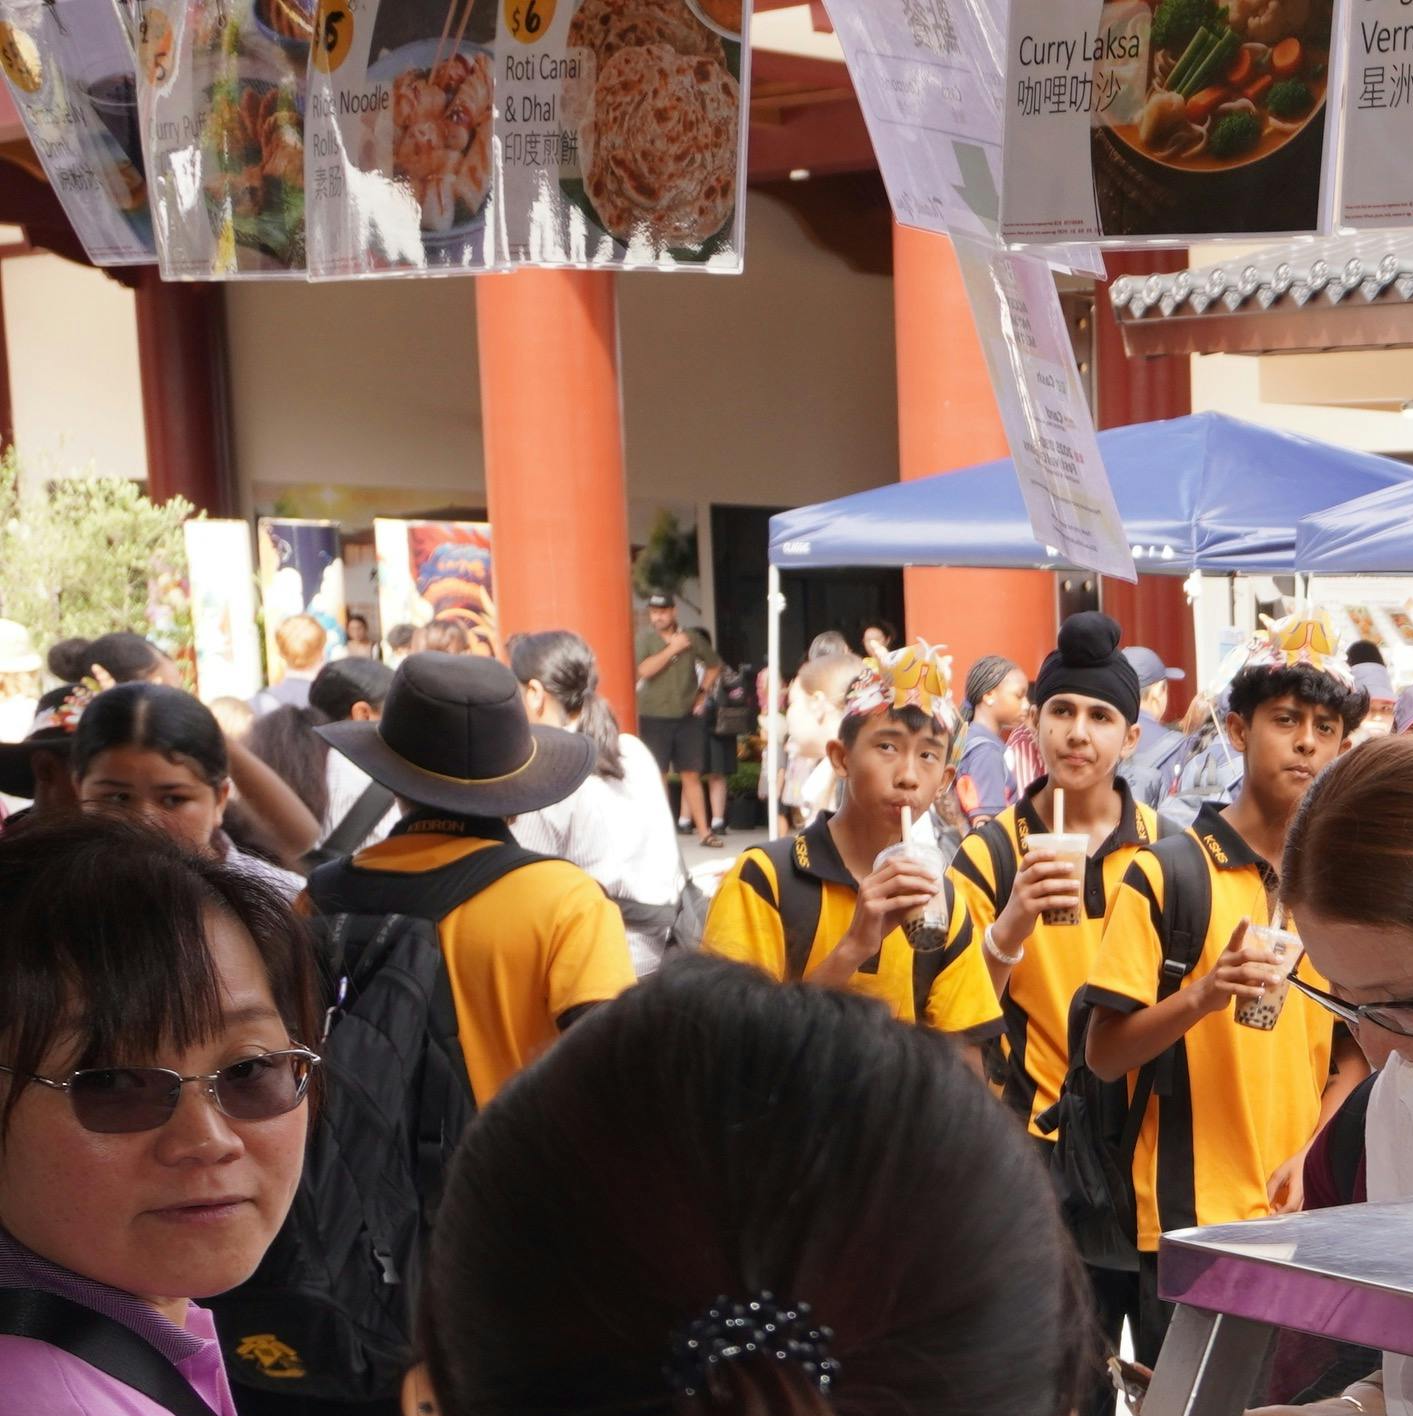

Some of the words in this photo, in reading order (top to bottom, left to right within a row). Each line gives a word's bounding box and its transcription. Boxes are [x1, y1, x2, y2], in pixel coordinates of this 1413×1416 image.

[1019, 36, 1077, 71] Curry
[1082, 27, 1140, 61] Laksa
[505, 54, 536, 80] Roti
[539, 52, 582, 80] Canai
[340, 86, 390, 115] Noodle
[504, 96, 516, 122] &
[521, 95, 556, 122] Dhal
[1017, 70, 1121, 117] 咖哩叻沙
[504, 131, 579, 167] 印度煎餅
[314, 168, 345, 201] 素肠
[1203, 833, 1228, 865] KSHS
